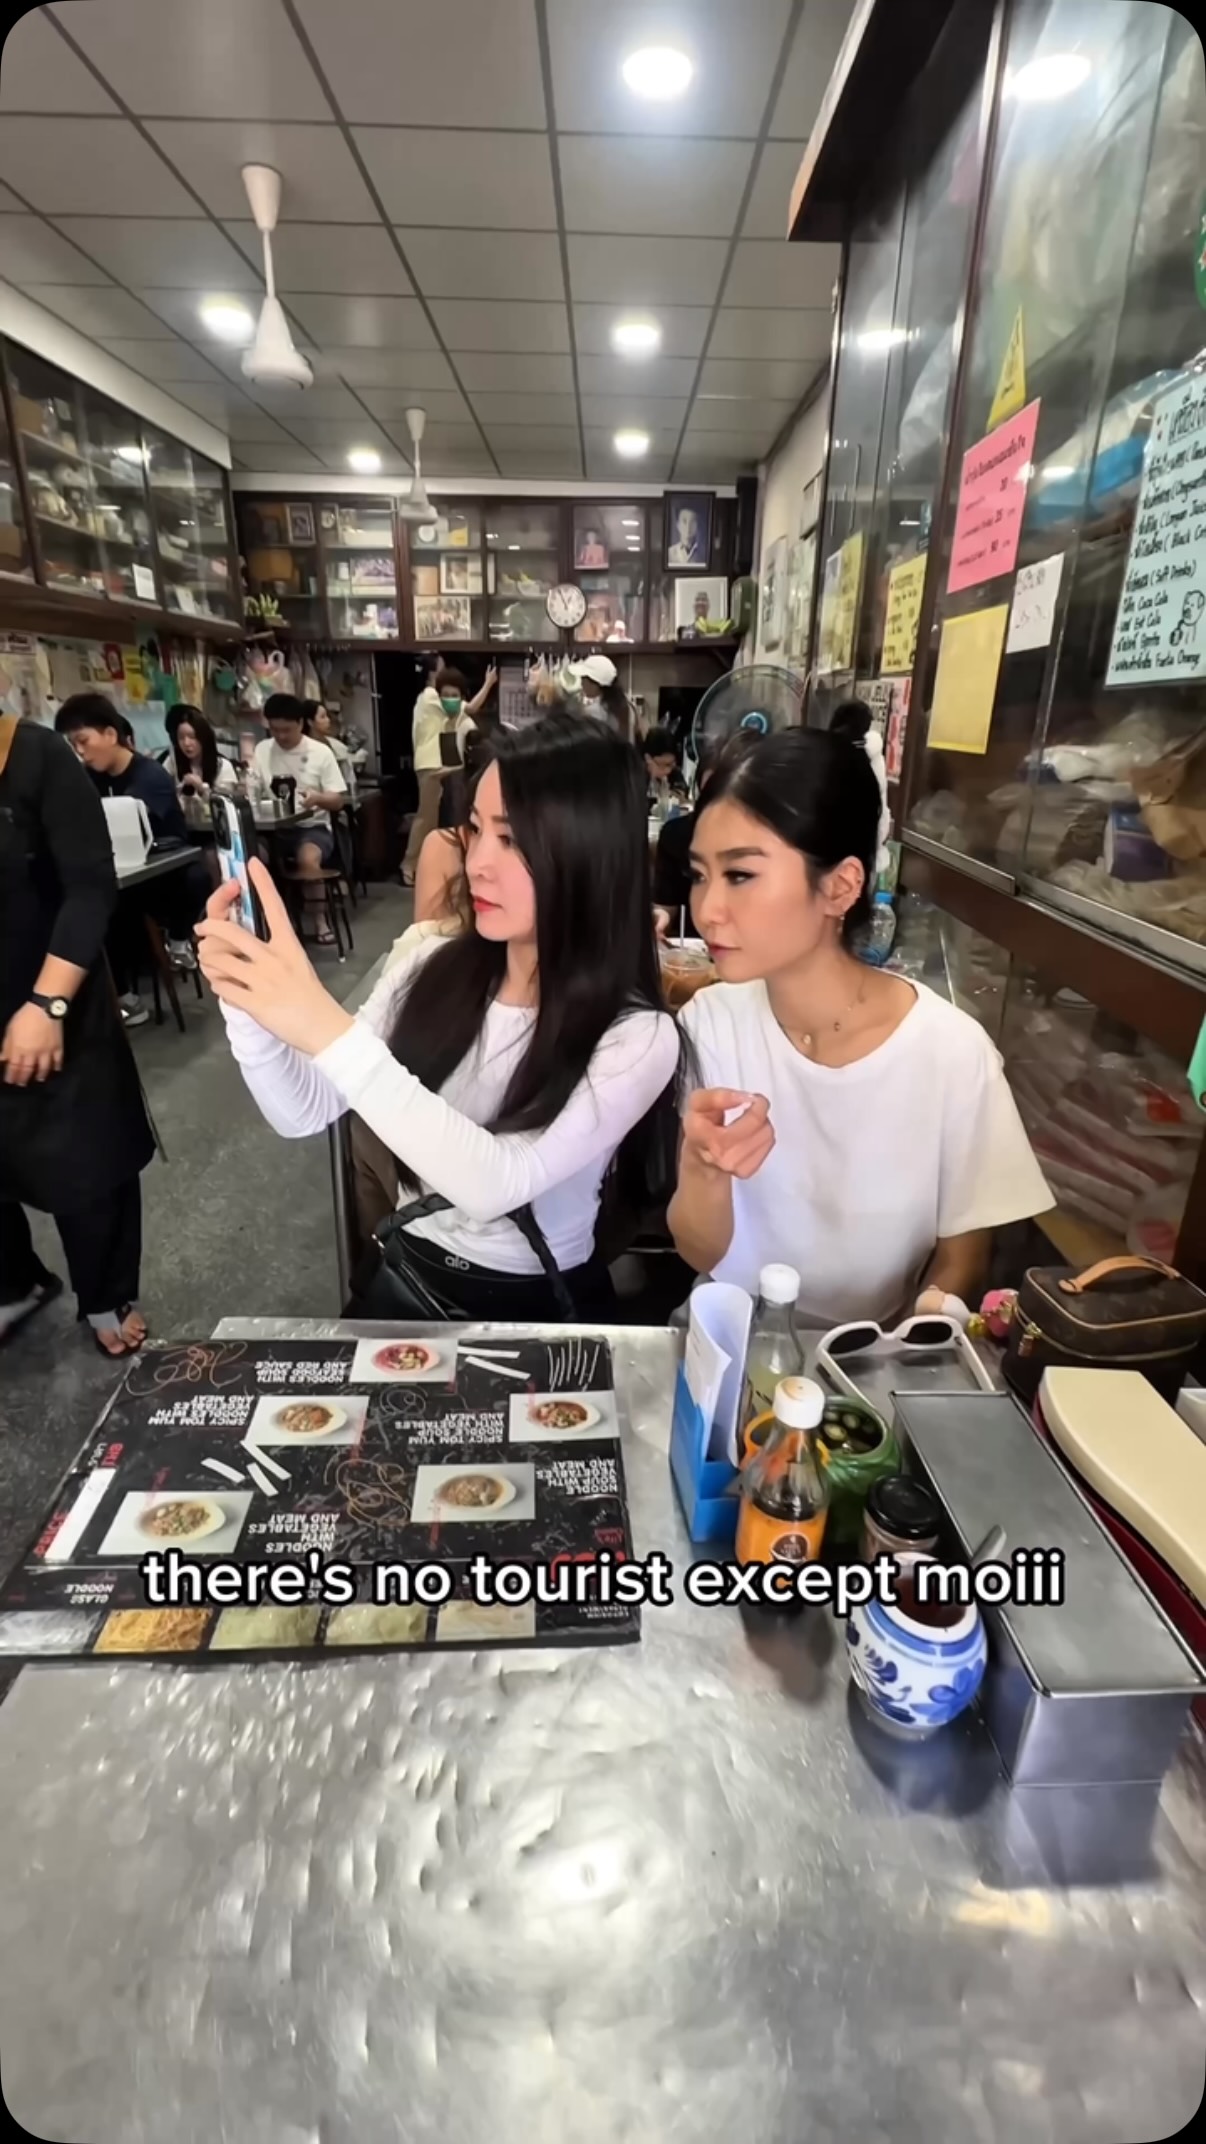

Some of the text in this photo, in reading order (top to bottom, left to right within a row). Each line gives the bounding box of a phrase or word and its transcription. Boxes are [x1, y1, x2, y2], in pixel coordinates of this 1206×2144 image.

[445, 1255, 470, 1271] alo
[289, 1374, 344, 1383] NOODLES
[467, 1434, 503, 1444] SPICY
[551, 1458, 615, 1471] AND MEAT
[535, 1466, 617, 1480] VEGETABLES
[565, 1483, 618, 1495] NOODLE
[267, 1513, 340, 1524] AND MEAT
[247, 1522, 336, 1534] VEGETABLES
[300, 1531, 334, 1542] WITH
[64, 1583, 115, 1594] NOODLE
[69, 1593, 109, 1604] GLASS
